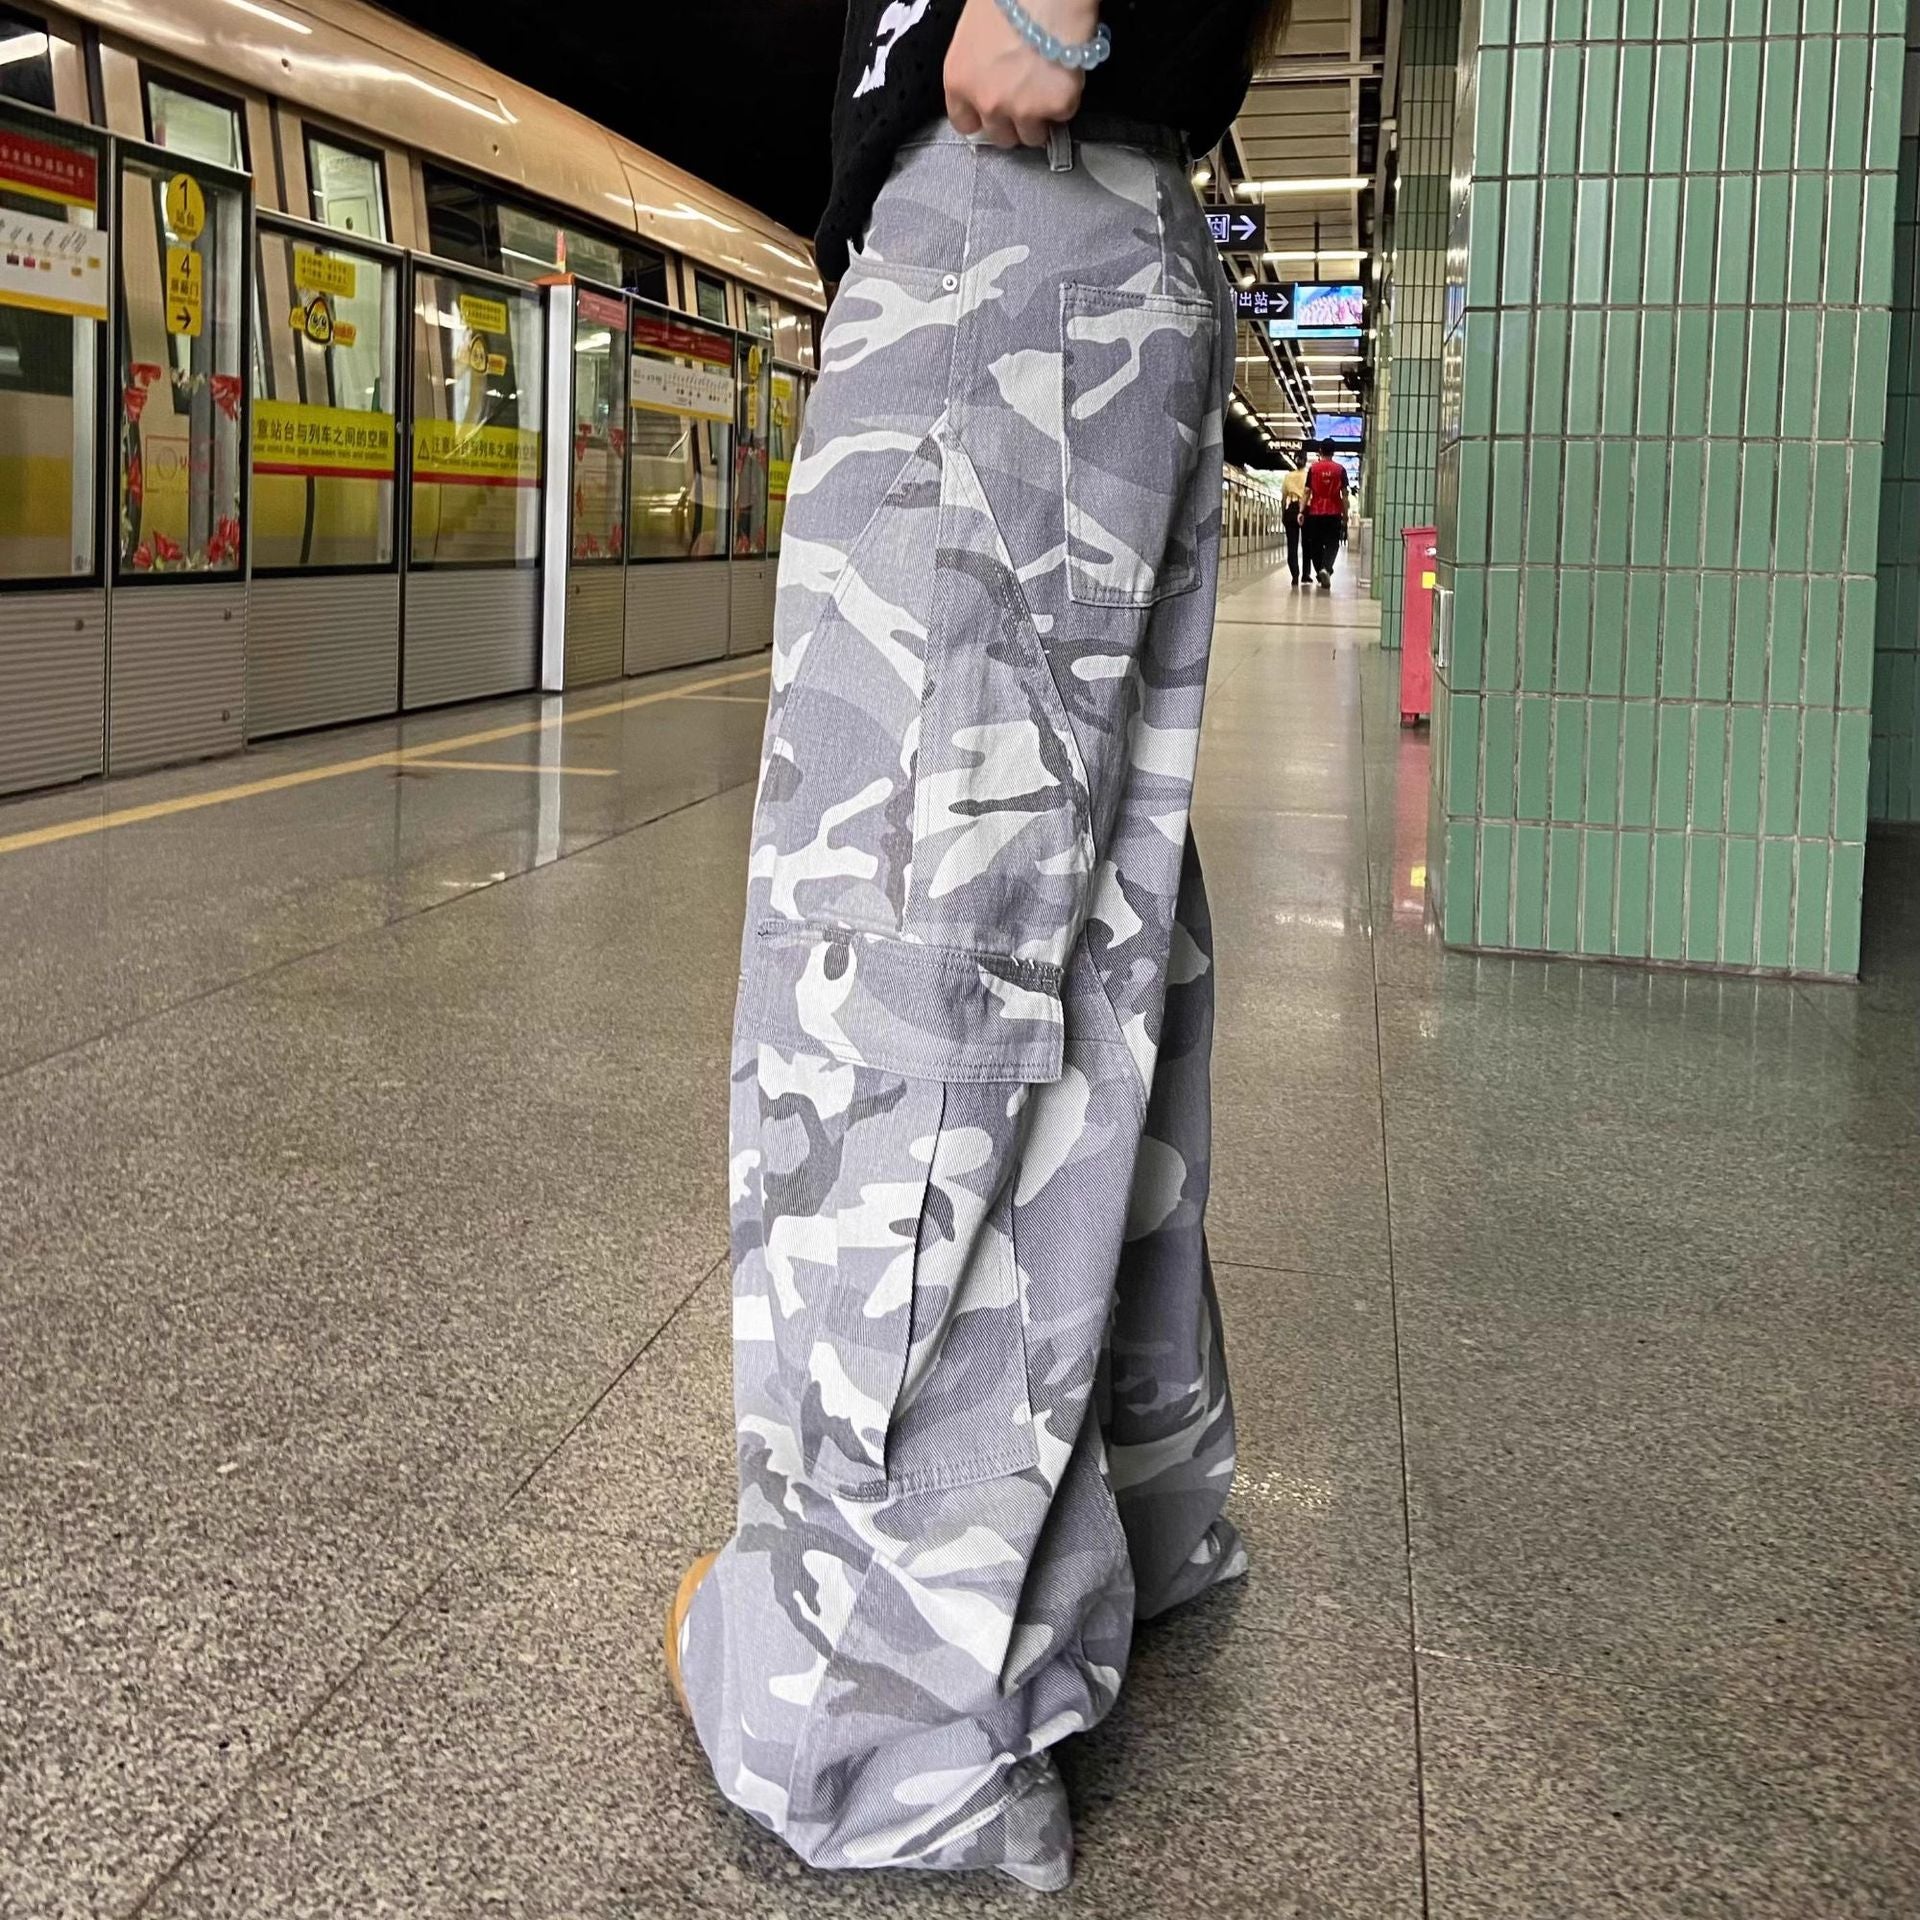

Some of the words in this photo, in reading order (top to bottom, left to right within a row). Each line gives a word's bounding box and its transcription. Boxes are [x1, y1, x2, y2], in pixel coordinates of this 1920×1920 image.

[179, 179, 188, 211] 1
[181, 254, 192, 279] 4
[1239, 291, 1268, 306] 出站
[1254, 306, 1268, 314] Exit
